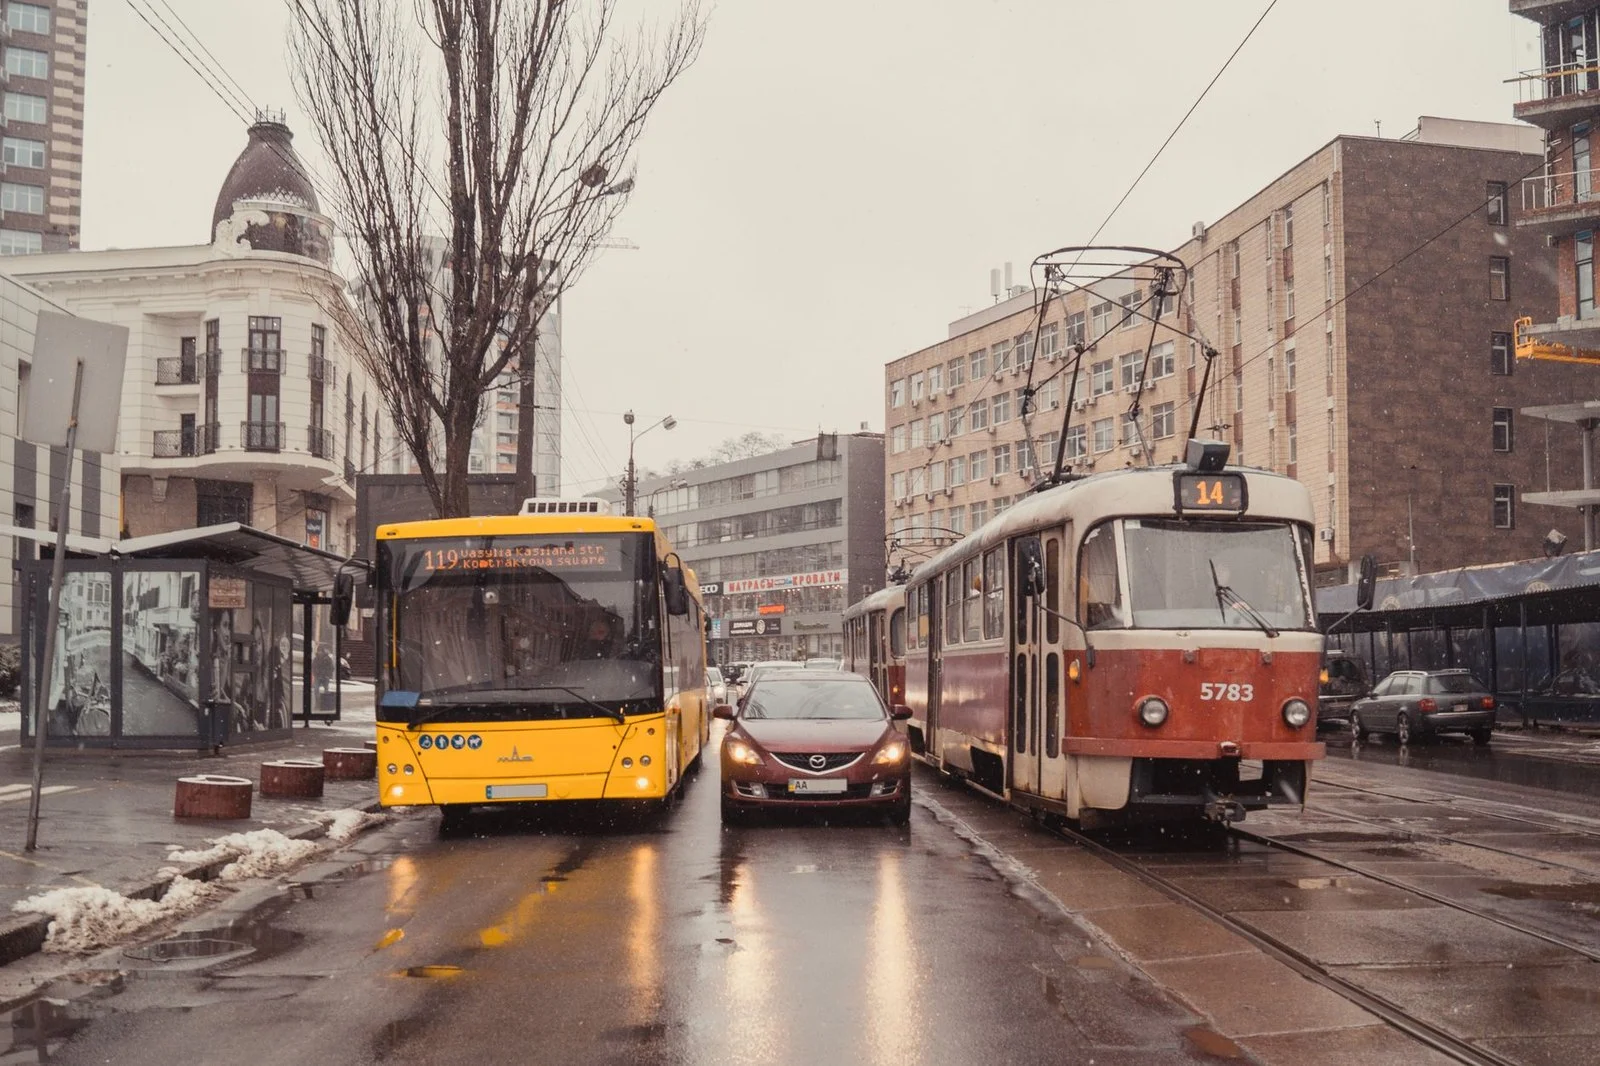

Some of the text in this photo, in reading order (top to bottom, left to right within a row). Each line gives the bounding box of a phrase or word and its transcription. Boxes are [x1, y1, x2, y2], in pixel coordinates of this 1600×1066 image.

[1196, 480, 1224, 504] 14
[424, 550, 459, 570] 119
[728, 578, 774, 592] МАТРАСЫ
[792, 572, 841, 586] КРОВАТИ
[1200, 682, 1254, 702] 5783
